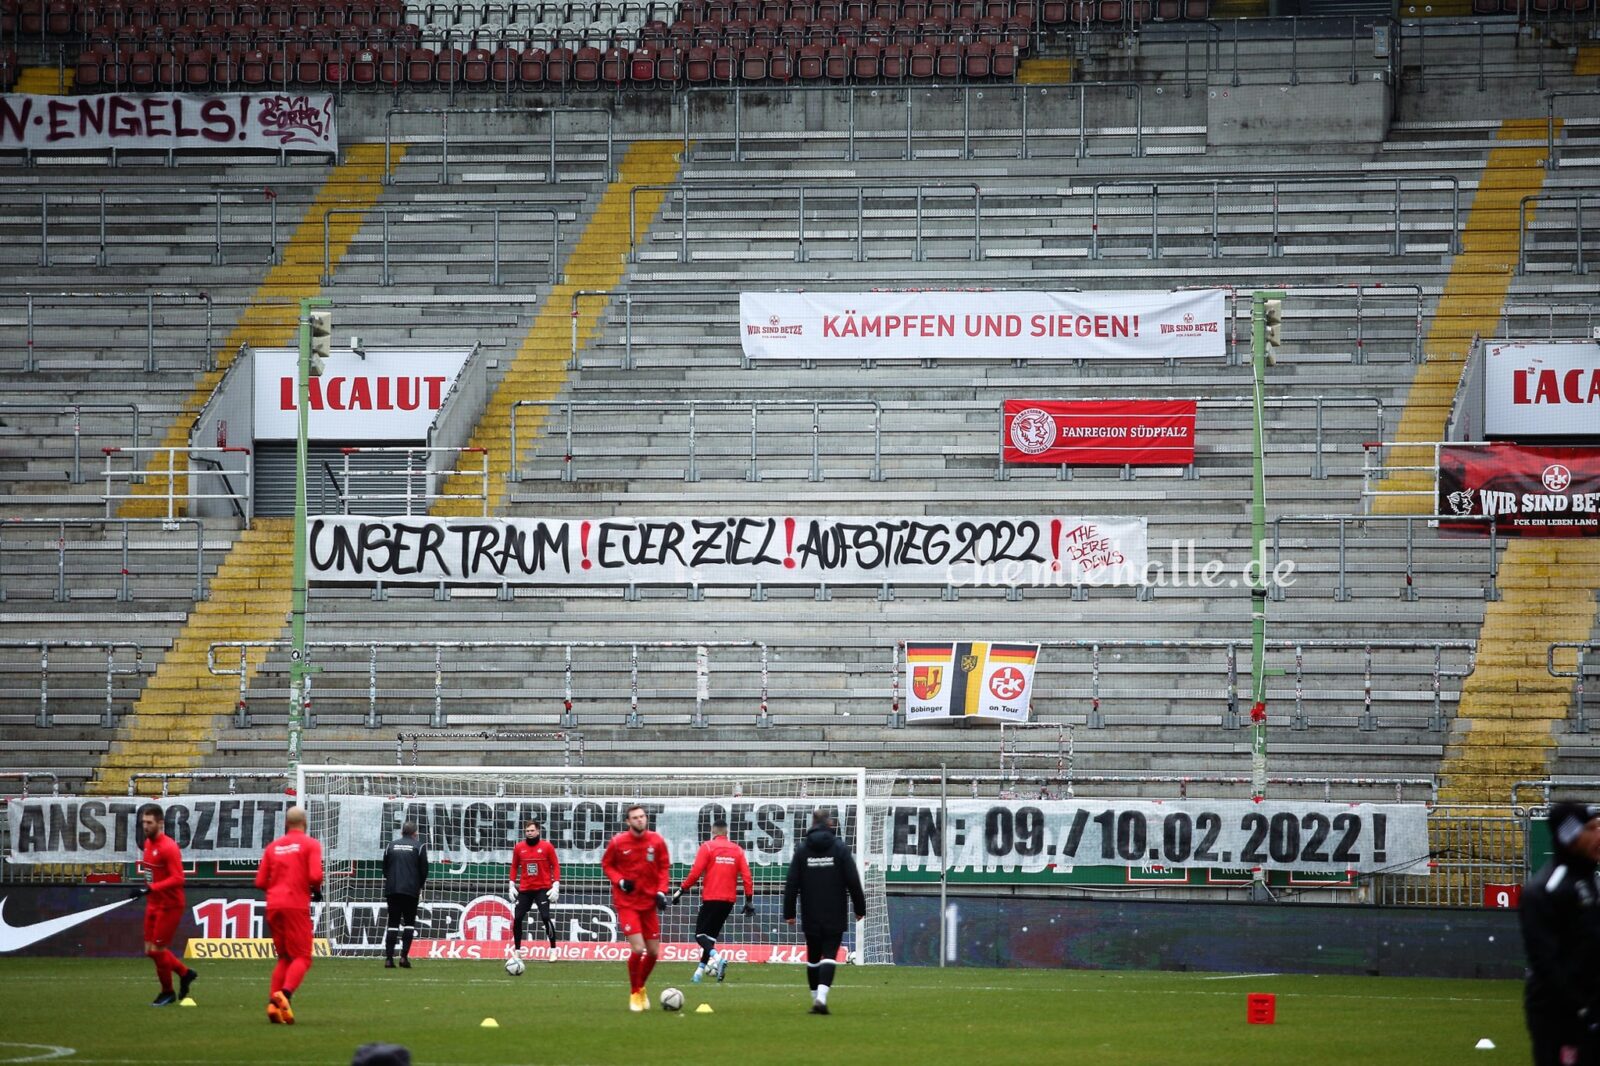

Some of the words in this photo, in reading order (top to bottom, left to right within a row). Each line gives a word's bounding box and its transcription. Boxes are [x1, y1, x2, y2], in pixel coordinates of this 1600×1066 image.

[823, 310, 955, 338] KÄMPFEN
[965, 315, 1022, 337] UND
[1030, 315, 1139, 338] SIEGEN!
[280, 376, 446, 411] LACALUT
[1062, 427, 1127, 438] FANREGION
[1130, 425, 1188, 438] SÜDPFALZ
[1480, 489, 1518, 515] WIR
[1521, 493, 1569, 513] SIND
[1066, 525, 1099, 544] THE
[310, 519, 451, 576] UNSER
[599, 521, 689, 568] EUER
[910, 705, 943, 714] Böbinger
[1002, 705, 1019, 714] Tour
[769, 945, 805, 963] kk
